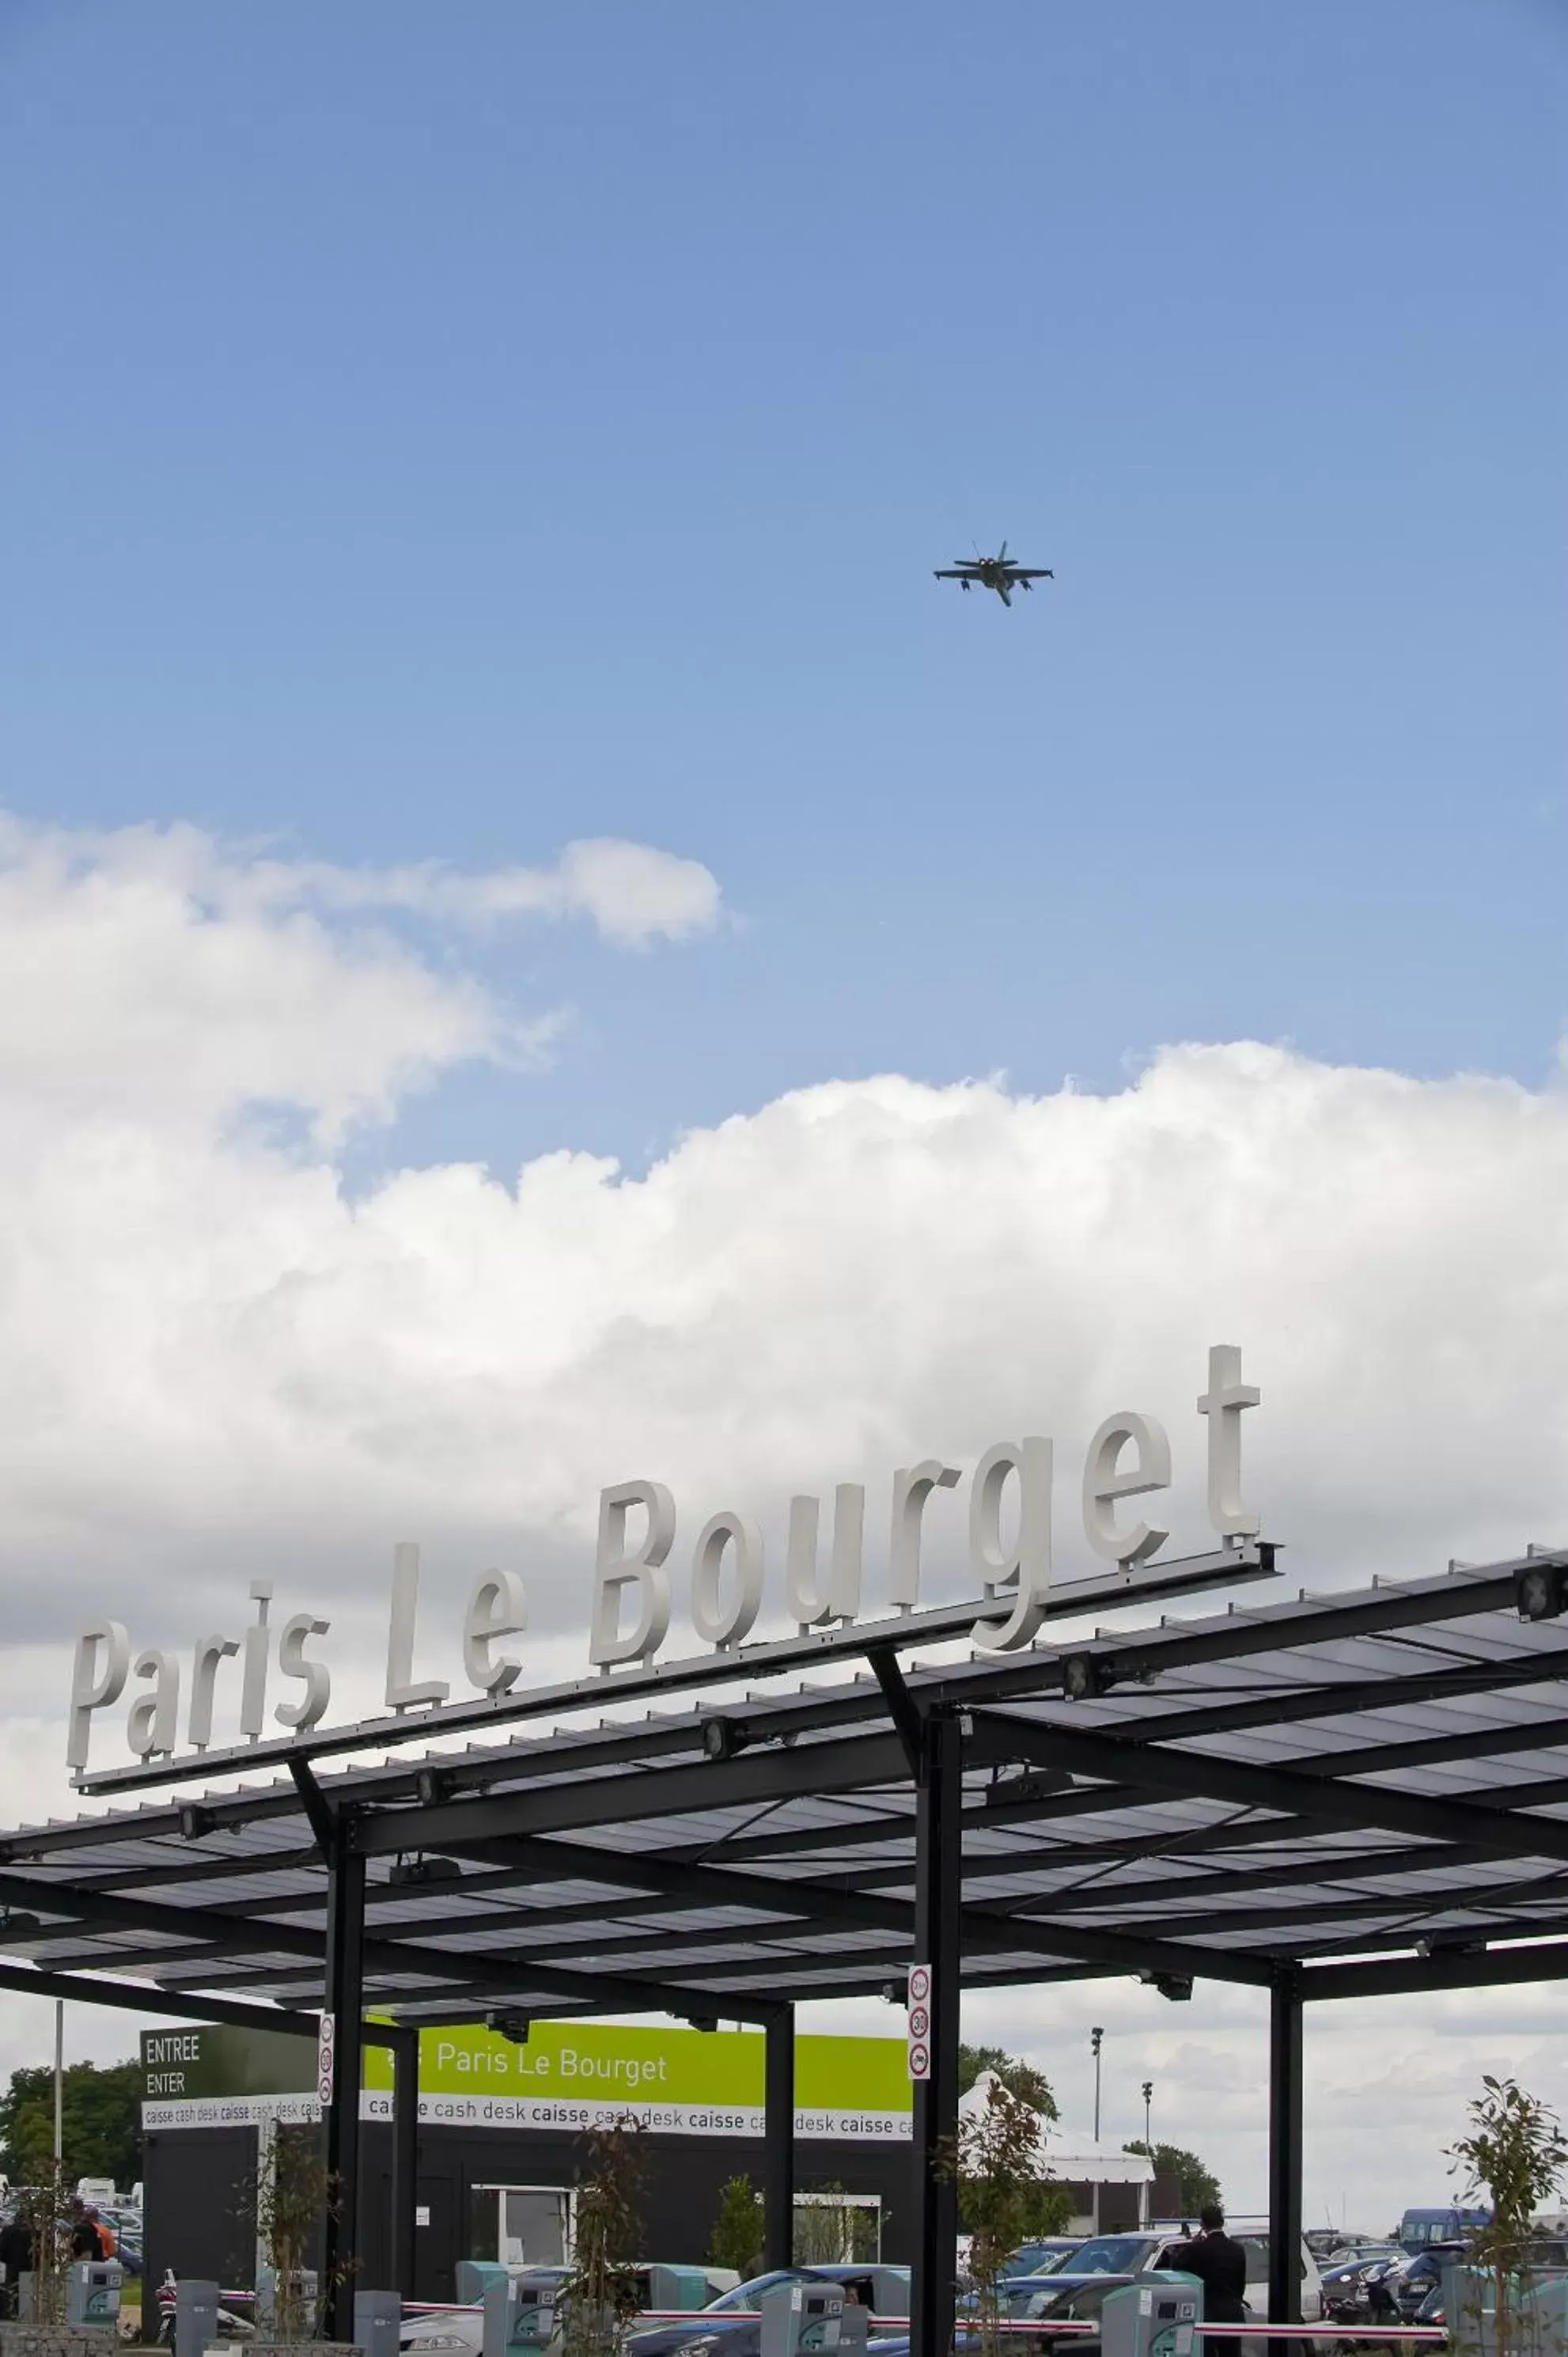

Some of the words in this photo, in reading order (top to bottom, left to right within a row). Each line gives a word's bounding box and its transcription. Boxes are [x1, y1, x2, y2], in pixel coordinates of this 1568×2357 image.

[66, 1580, 331, 1768] Paris
[386, 1542, 528, 1707] Le
[589, 1345, 1260, 1650] Bourget
[146, 2035, 200, 2064] ENTREE
[437, 2043, 509, 2073] Paris
[519, 2048, 550, 2075] Le
[560, 2048, 668, 2087] Bourget
[146, 2072, 185, 2094] ENTER
[146, 2107, 173, 2124] caisse
[176, 2105, 195, 2122] cash
[221, 2102, 249, 2120] caisse
[434, 2101, 476, 2118] cash
[483, 2101, 525, 2120] desk
[532, 2104, 589, 2123] caisse
[642, 2108, 684, 2128] desk
[689, 2110, 744, 2128] caisse
[795, 2114, 835, 2132] desk
[840, 2116, 893, 2134] caisse
